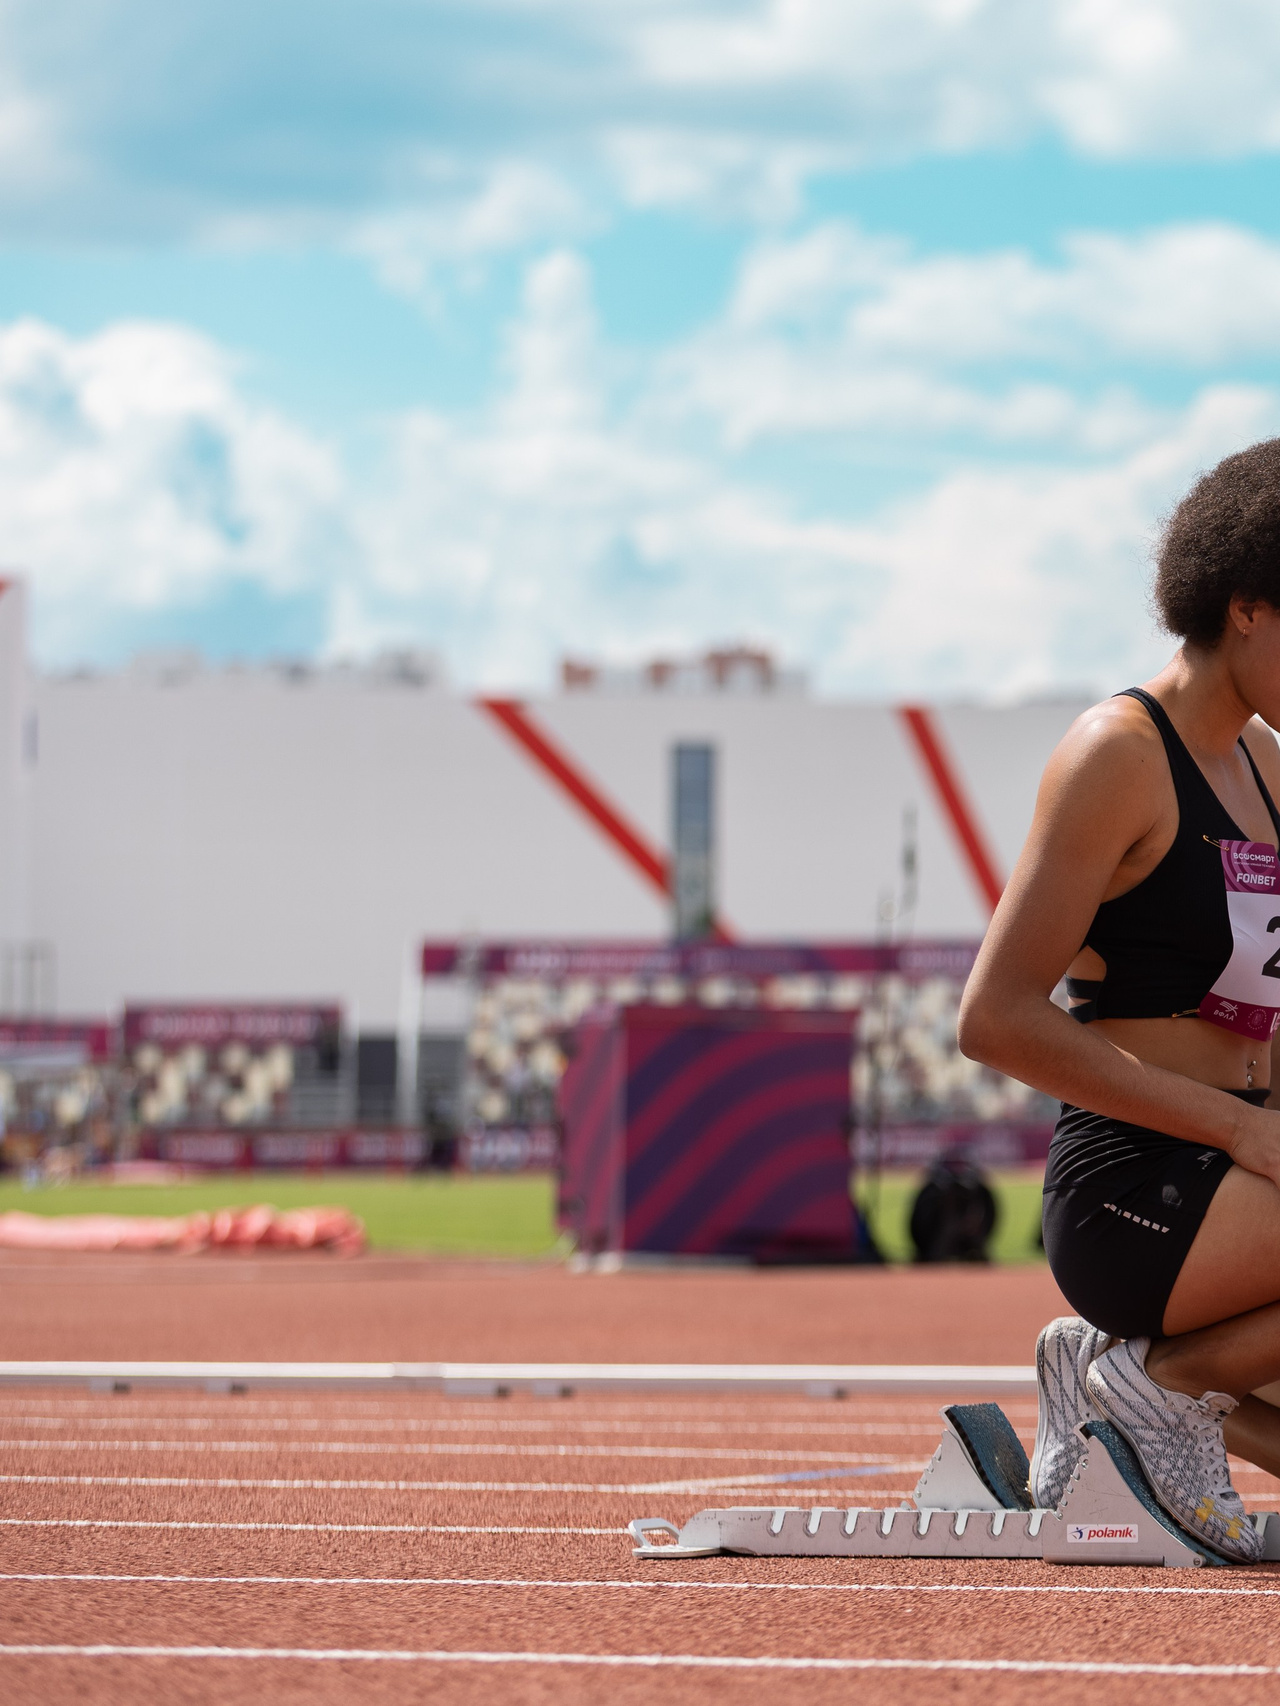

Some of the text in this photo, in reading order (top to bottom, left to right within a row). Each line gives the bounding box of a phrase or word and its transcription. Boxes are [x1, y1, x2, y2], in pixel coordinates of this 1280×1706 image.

[1236, 873, 1276, 887] FONBET
[1213, 1009, 1235, 1022] ВФЛА
[1087, 1527, 1133, 1540] polanik
